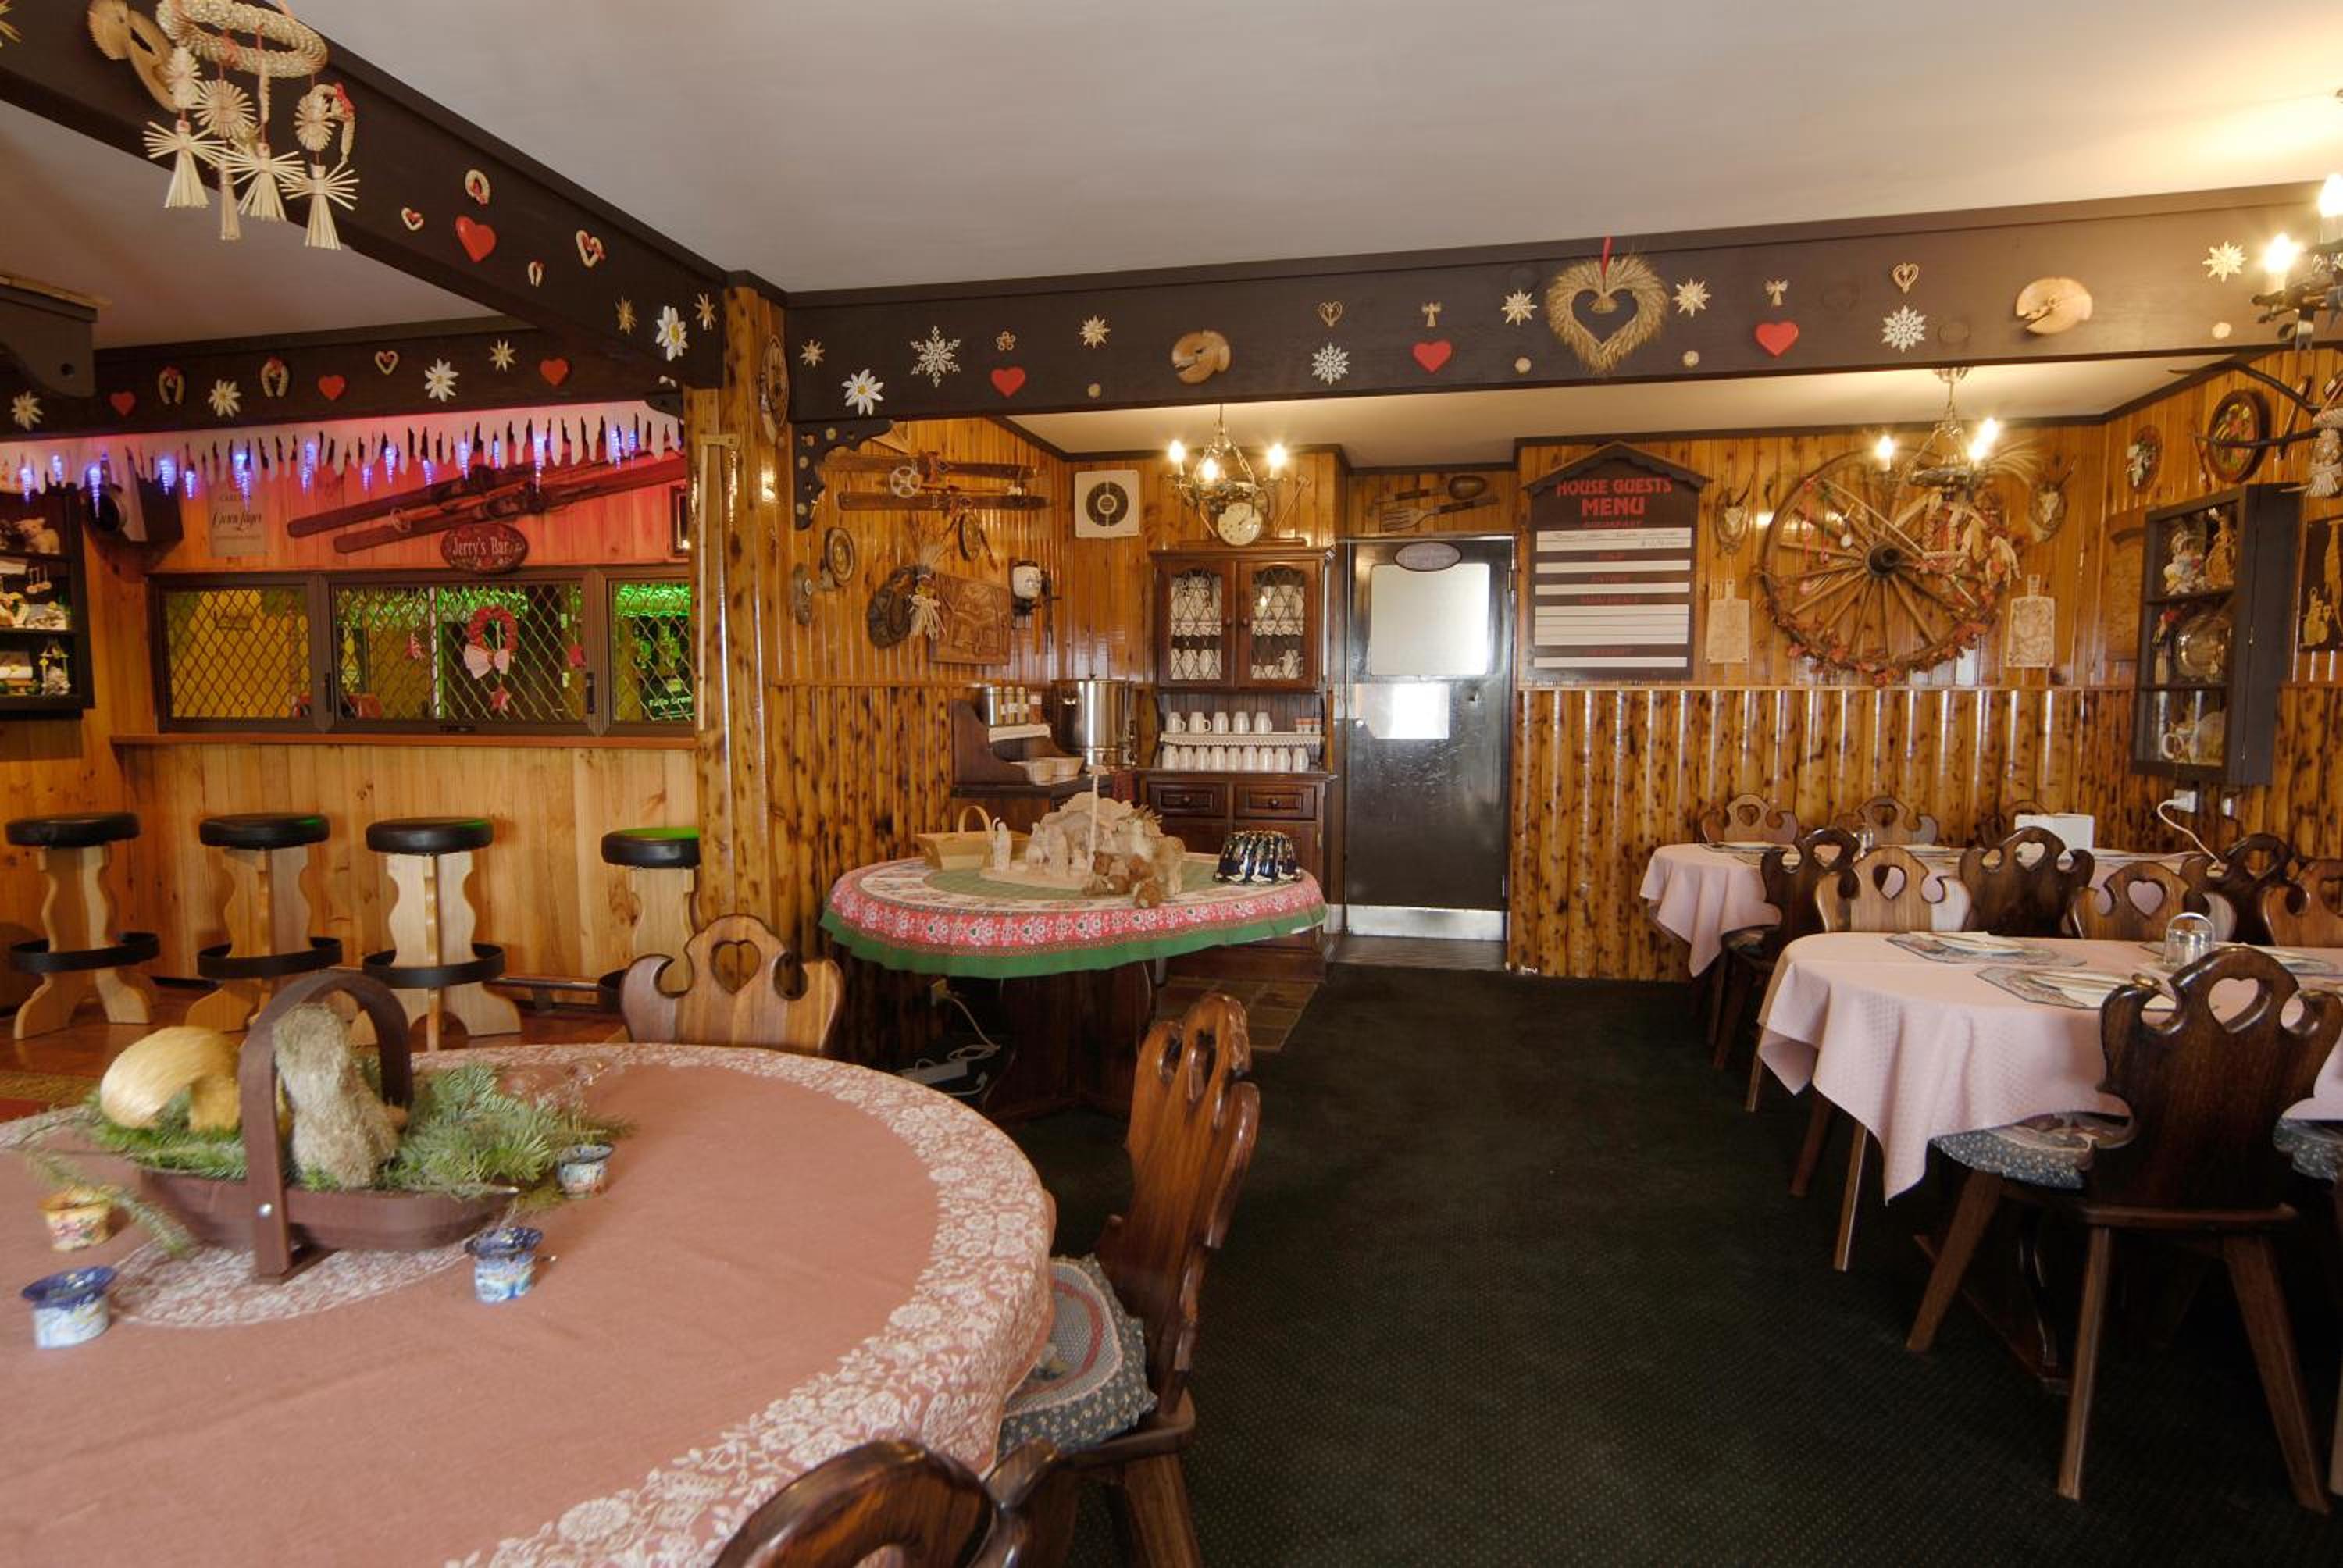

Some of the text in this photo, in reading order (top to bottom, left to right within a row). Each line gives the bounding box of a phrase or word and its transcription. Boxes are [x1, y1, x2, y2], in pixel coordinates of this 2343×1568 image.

[1556, 477, 1673, 497] HOUSE GUESTS
[1581, 497, 1646, 516] MENU
[452, 536, 510, 559] Jerry's Bar
